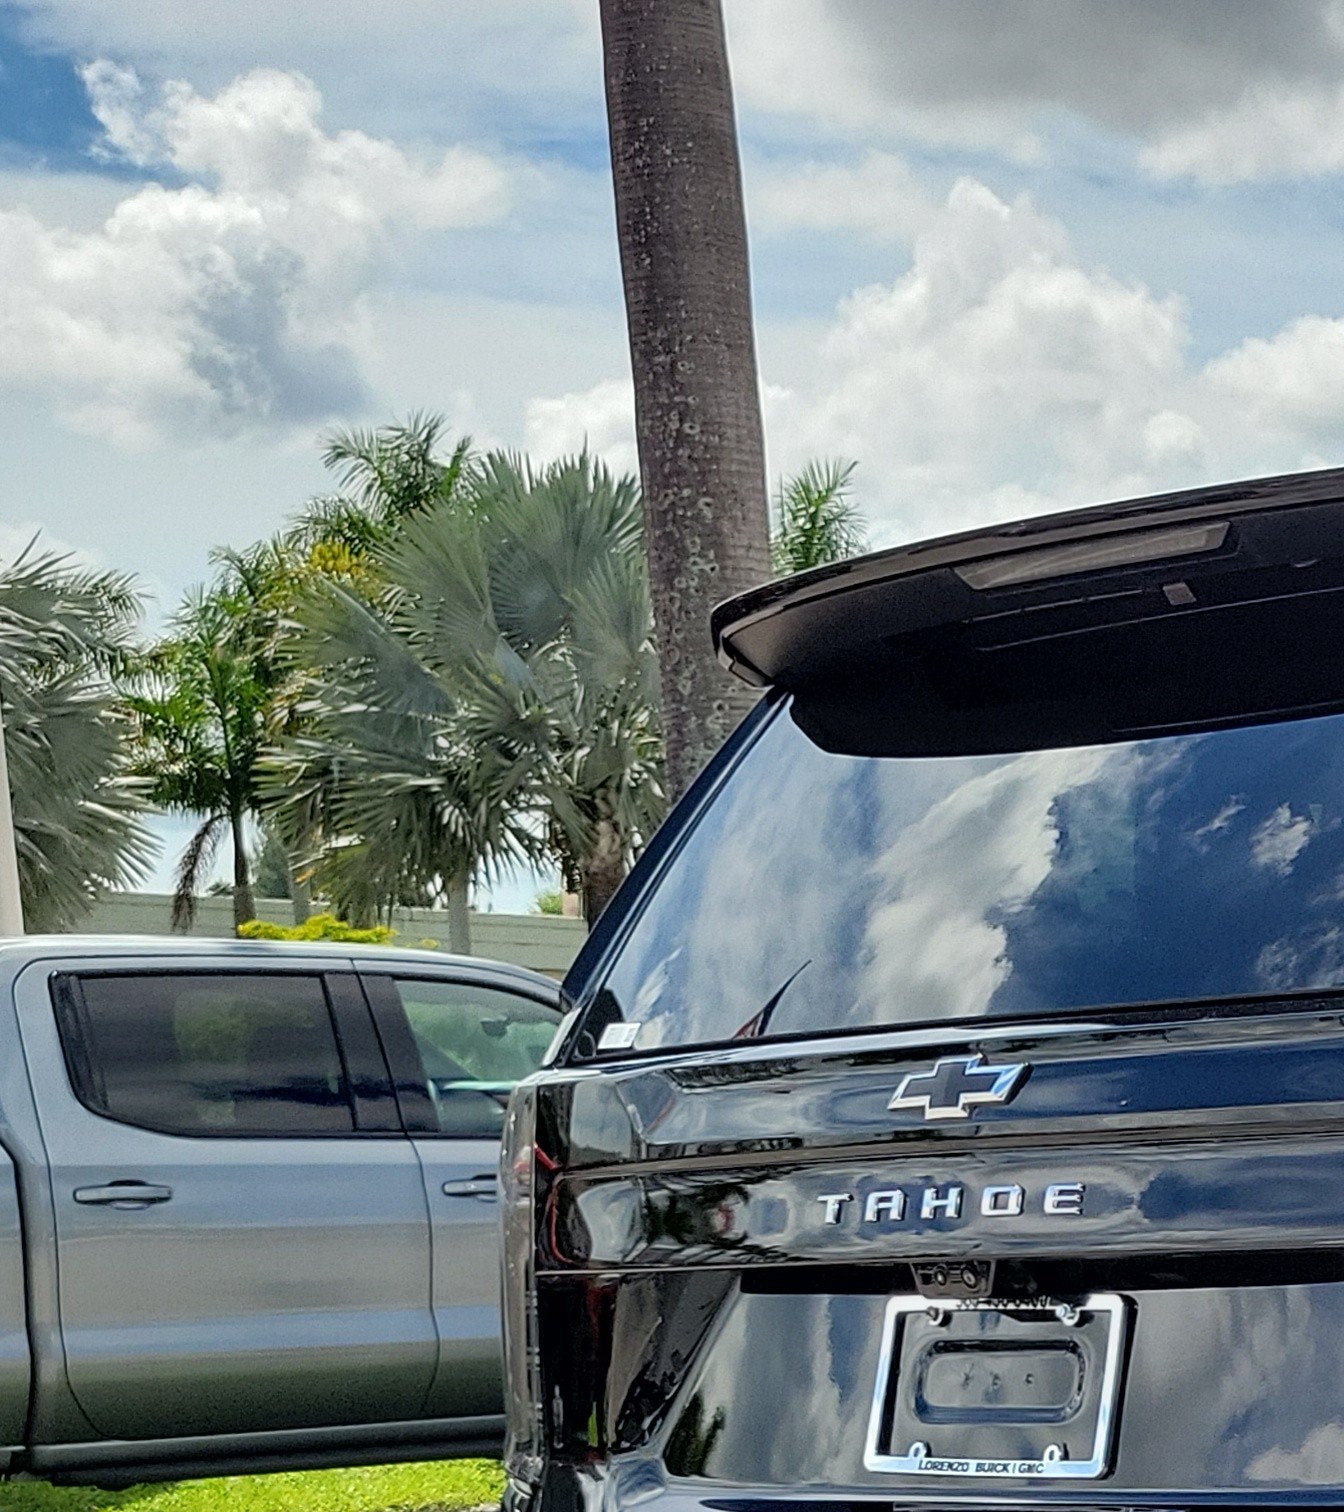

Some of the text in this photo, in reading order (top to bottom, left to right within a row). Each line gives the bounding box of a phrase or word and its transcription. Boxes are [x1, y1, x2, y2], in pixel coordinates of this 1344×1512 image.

[818, 1182, 1085, 1224] TAHOE
[918, 1460, 970, 1472] LORENZO
[975, 1463, 1010, 1473] BUICK
[1018, 1463, 1045, 1474] GMC
